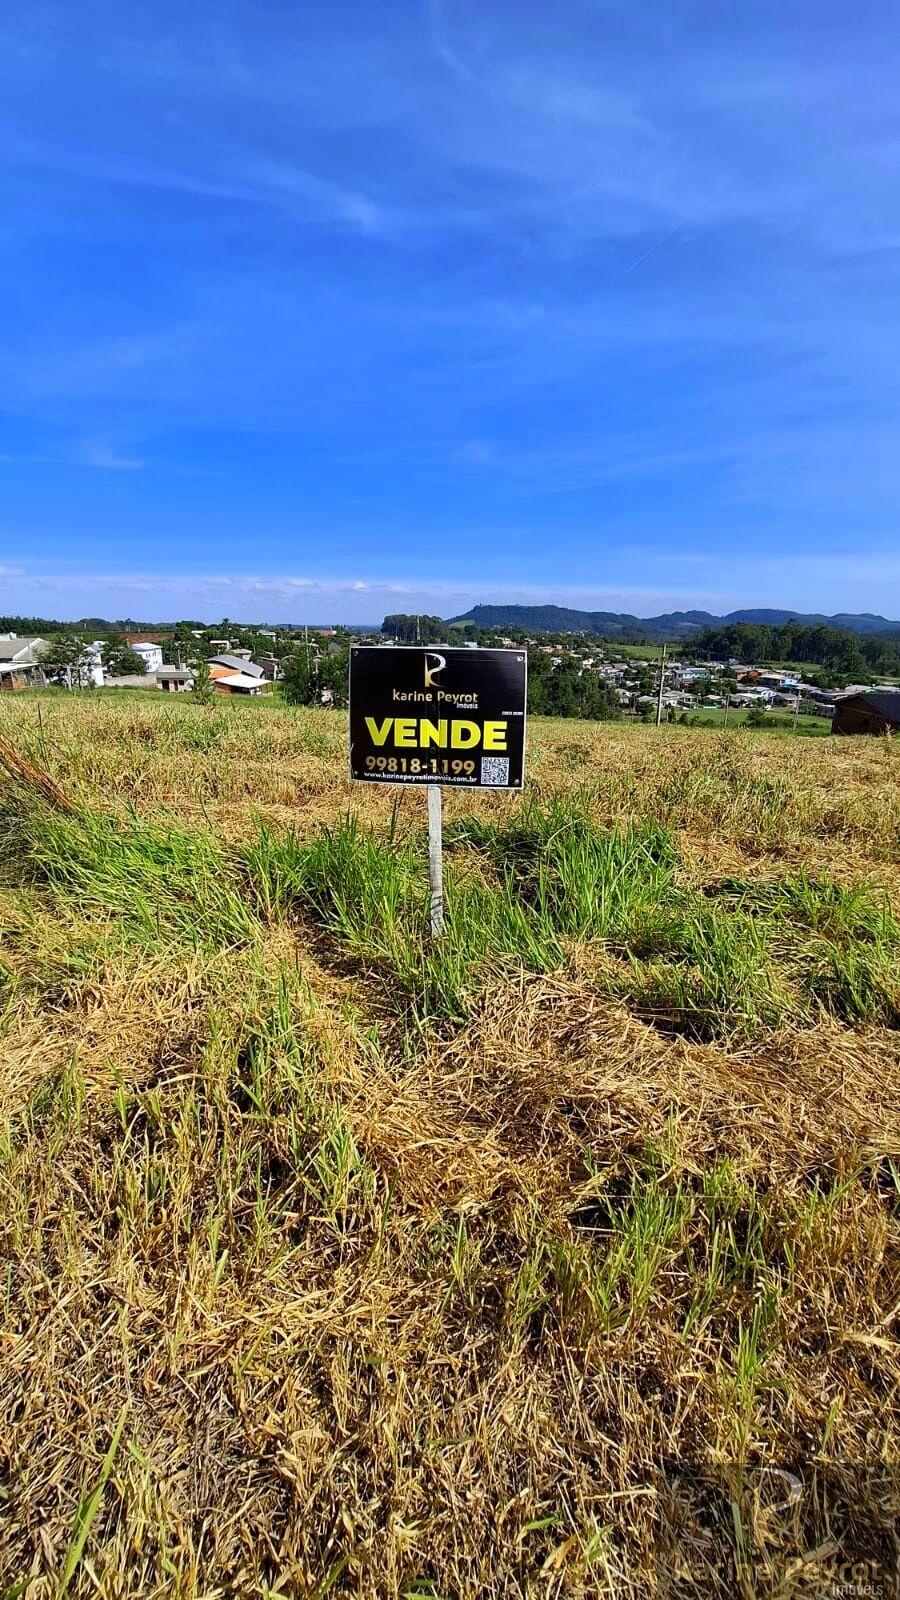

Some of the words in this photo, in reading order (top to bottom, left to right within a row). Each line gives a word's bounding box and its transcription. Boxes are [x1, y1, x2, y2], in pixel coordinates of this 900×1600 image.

[392, 688, 433, 702] karine
[437, 691, 479, 704] Peyrot
[364, 717, 508, 751] VENDE
[365, 756, 475, 775] 99818-1199
[363, 771, 478, 783] www.karinepeyrotimoveis.com.br
